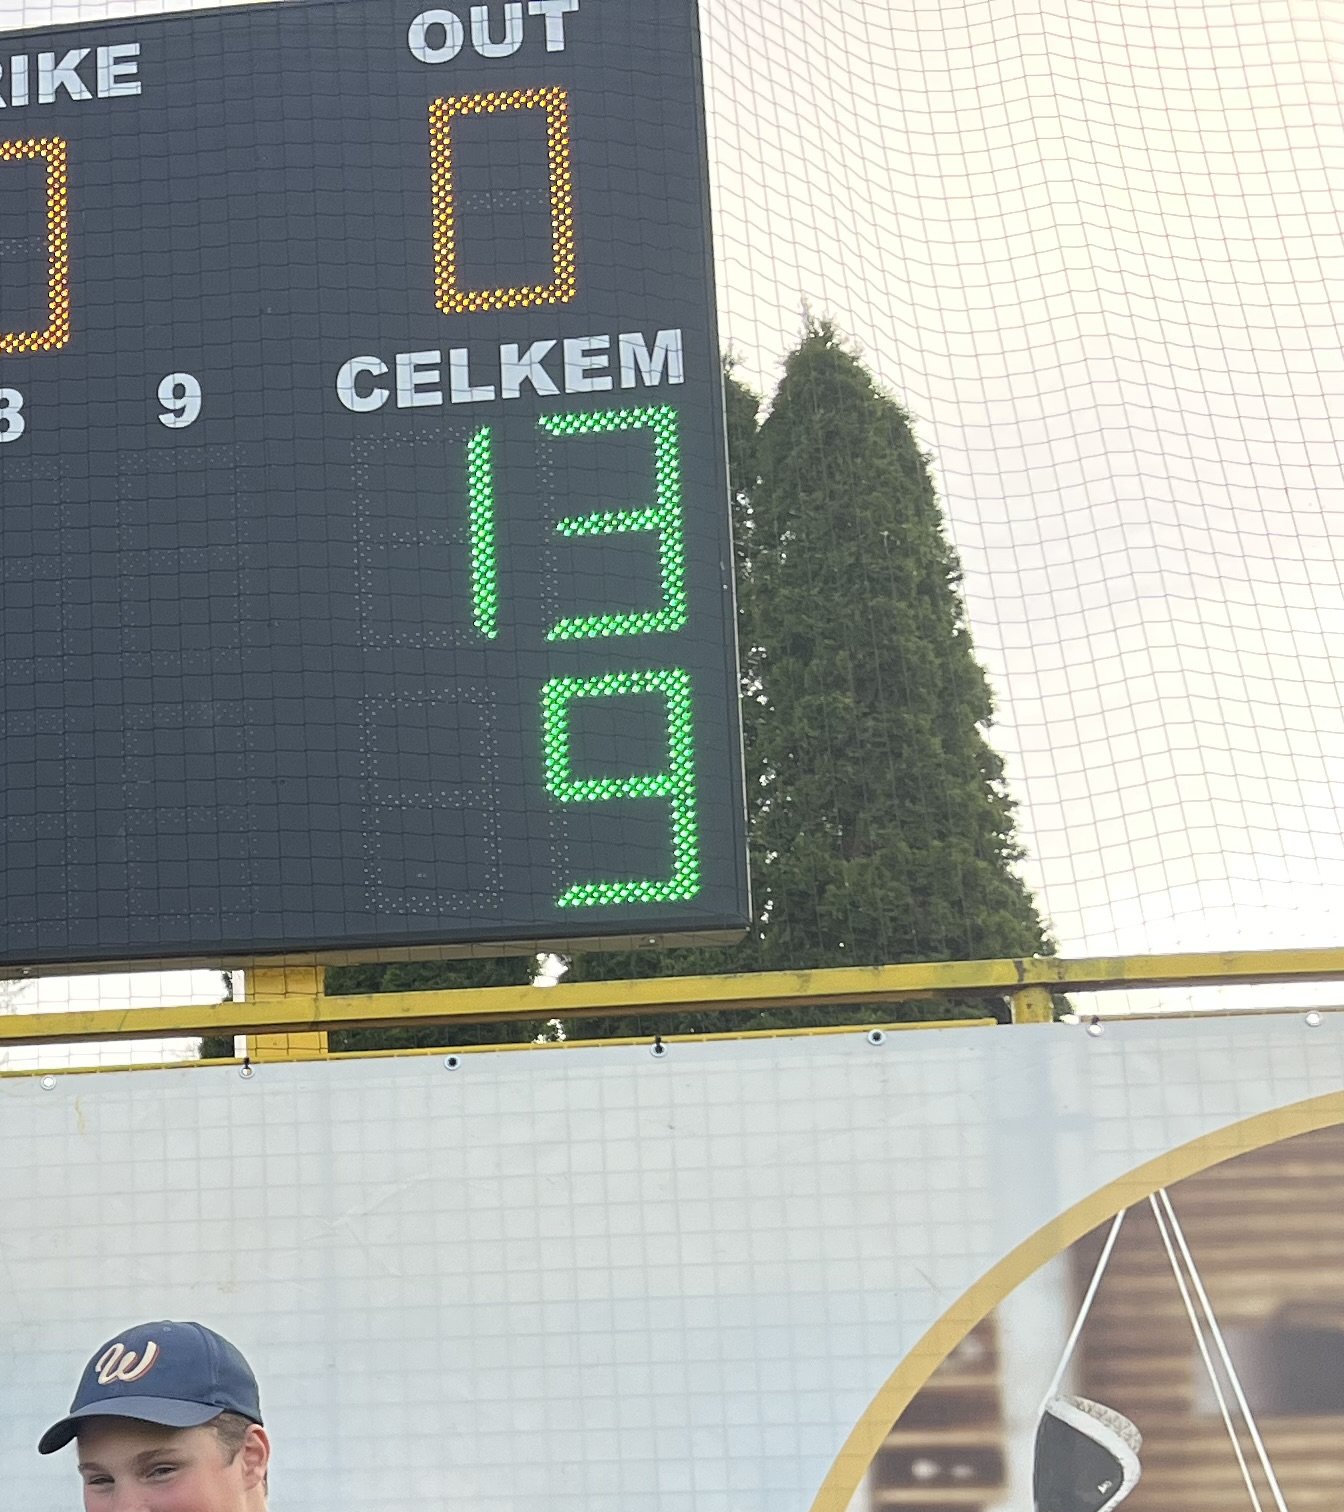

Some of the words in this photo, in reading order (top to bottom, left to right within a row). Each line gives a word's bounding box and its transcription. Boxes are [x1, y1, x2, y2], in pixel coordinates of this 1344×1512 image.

[408, 0, 579, 64] OUT
[427, 86, 576, 314] 0
[157, 372, 202, 428] 9
[335, 329, 685, 413] CELKEM
[466, 403, 689, 642] 13
[541, 666, 704, 909] 9
